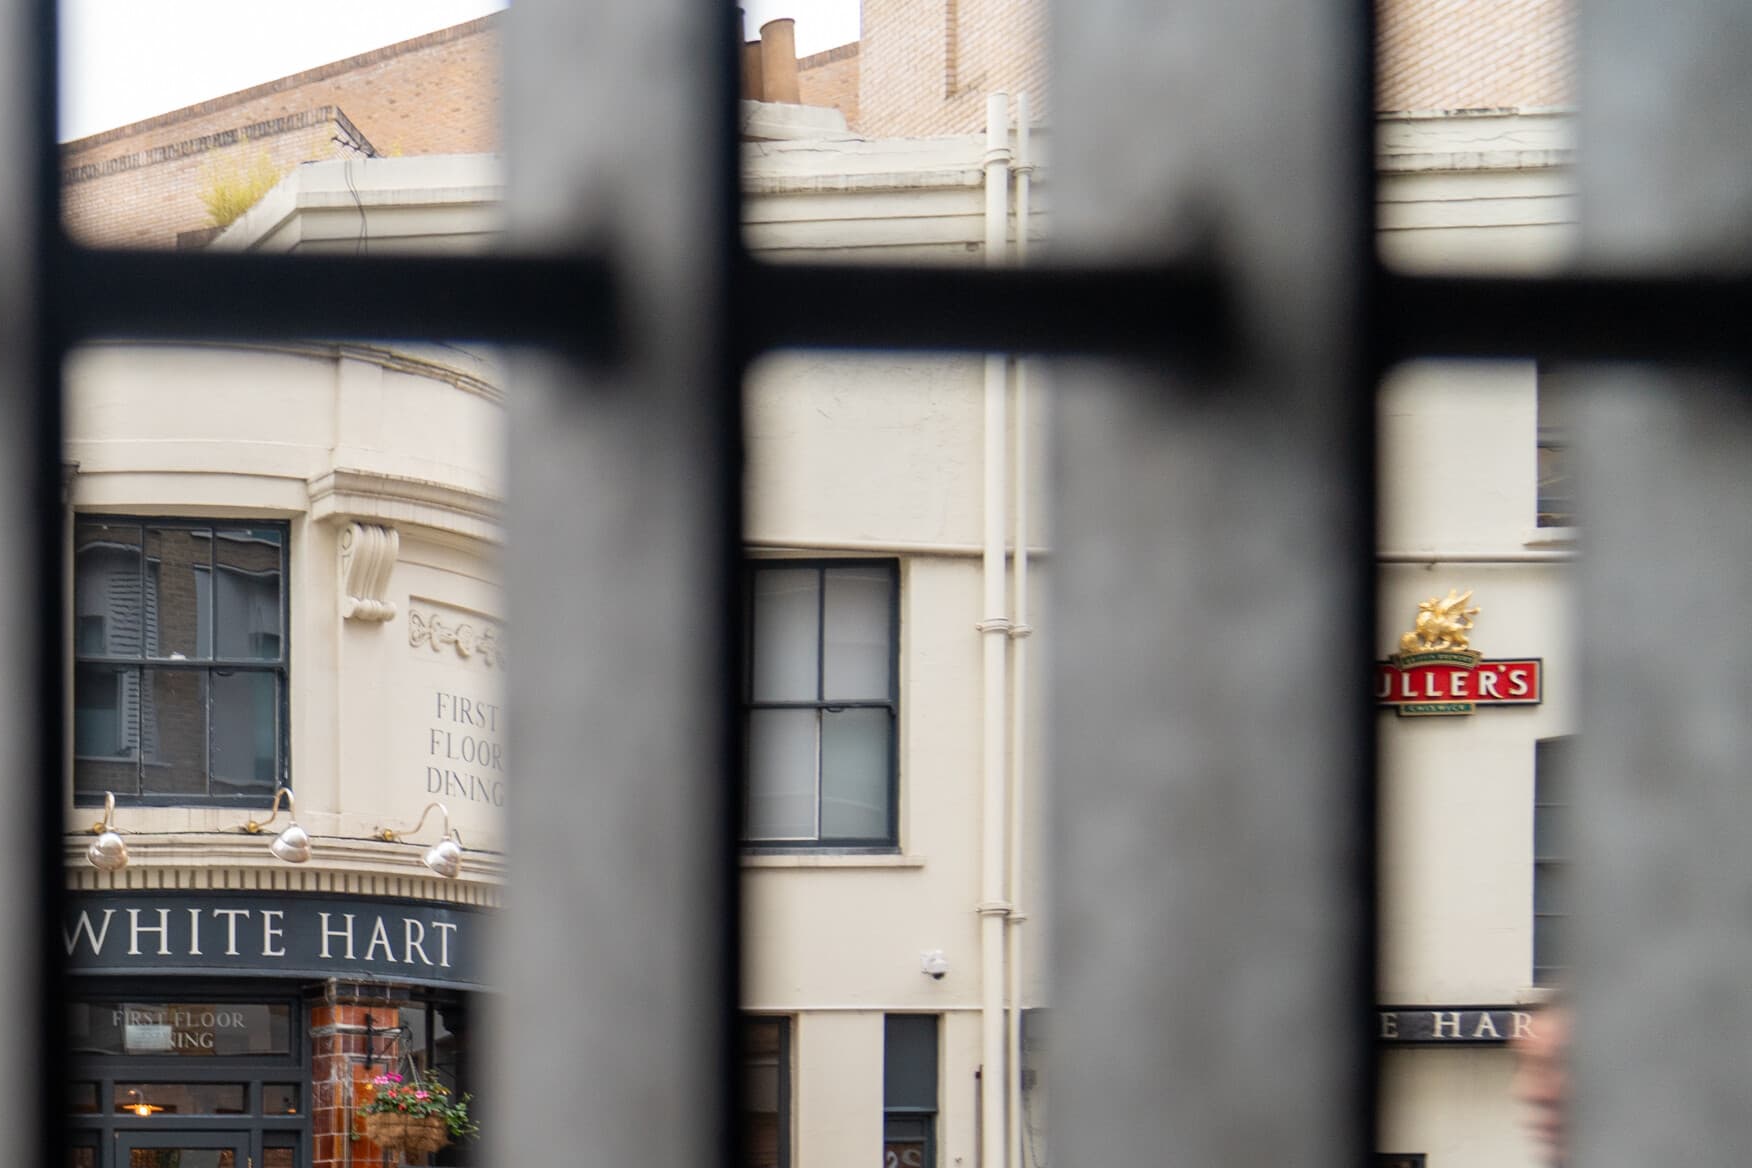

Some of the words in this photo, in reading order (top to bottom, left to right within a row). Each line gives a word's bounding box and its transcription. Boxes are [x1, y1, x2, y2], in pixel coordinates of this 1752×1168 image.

[1375, 664, 1528, 698] ULLER'S
[437, 692, 499, 733] FIRST
[430, 728, 504, 773] FLOOR
[426, 766, 504, 808] DINING
[63, 908, 286, 957] WHITE
[318, 911, 457, 968] HART
[112, 1011, 167, 1026] FIRST
[175, 1012, 245, 1028] FLOOR
[1432, 1011, 1539, 1038] HAR
